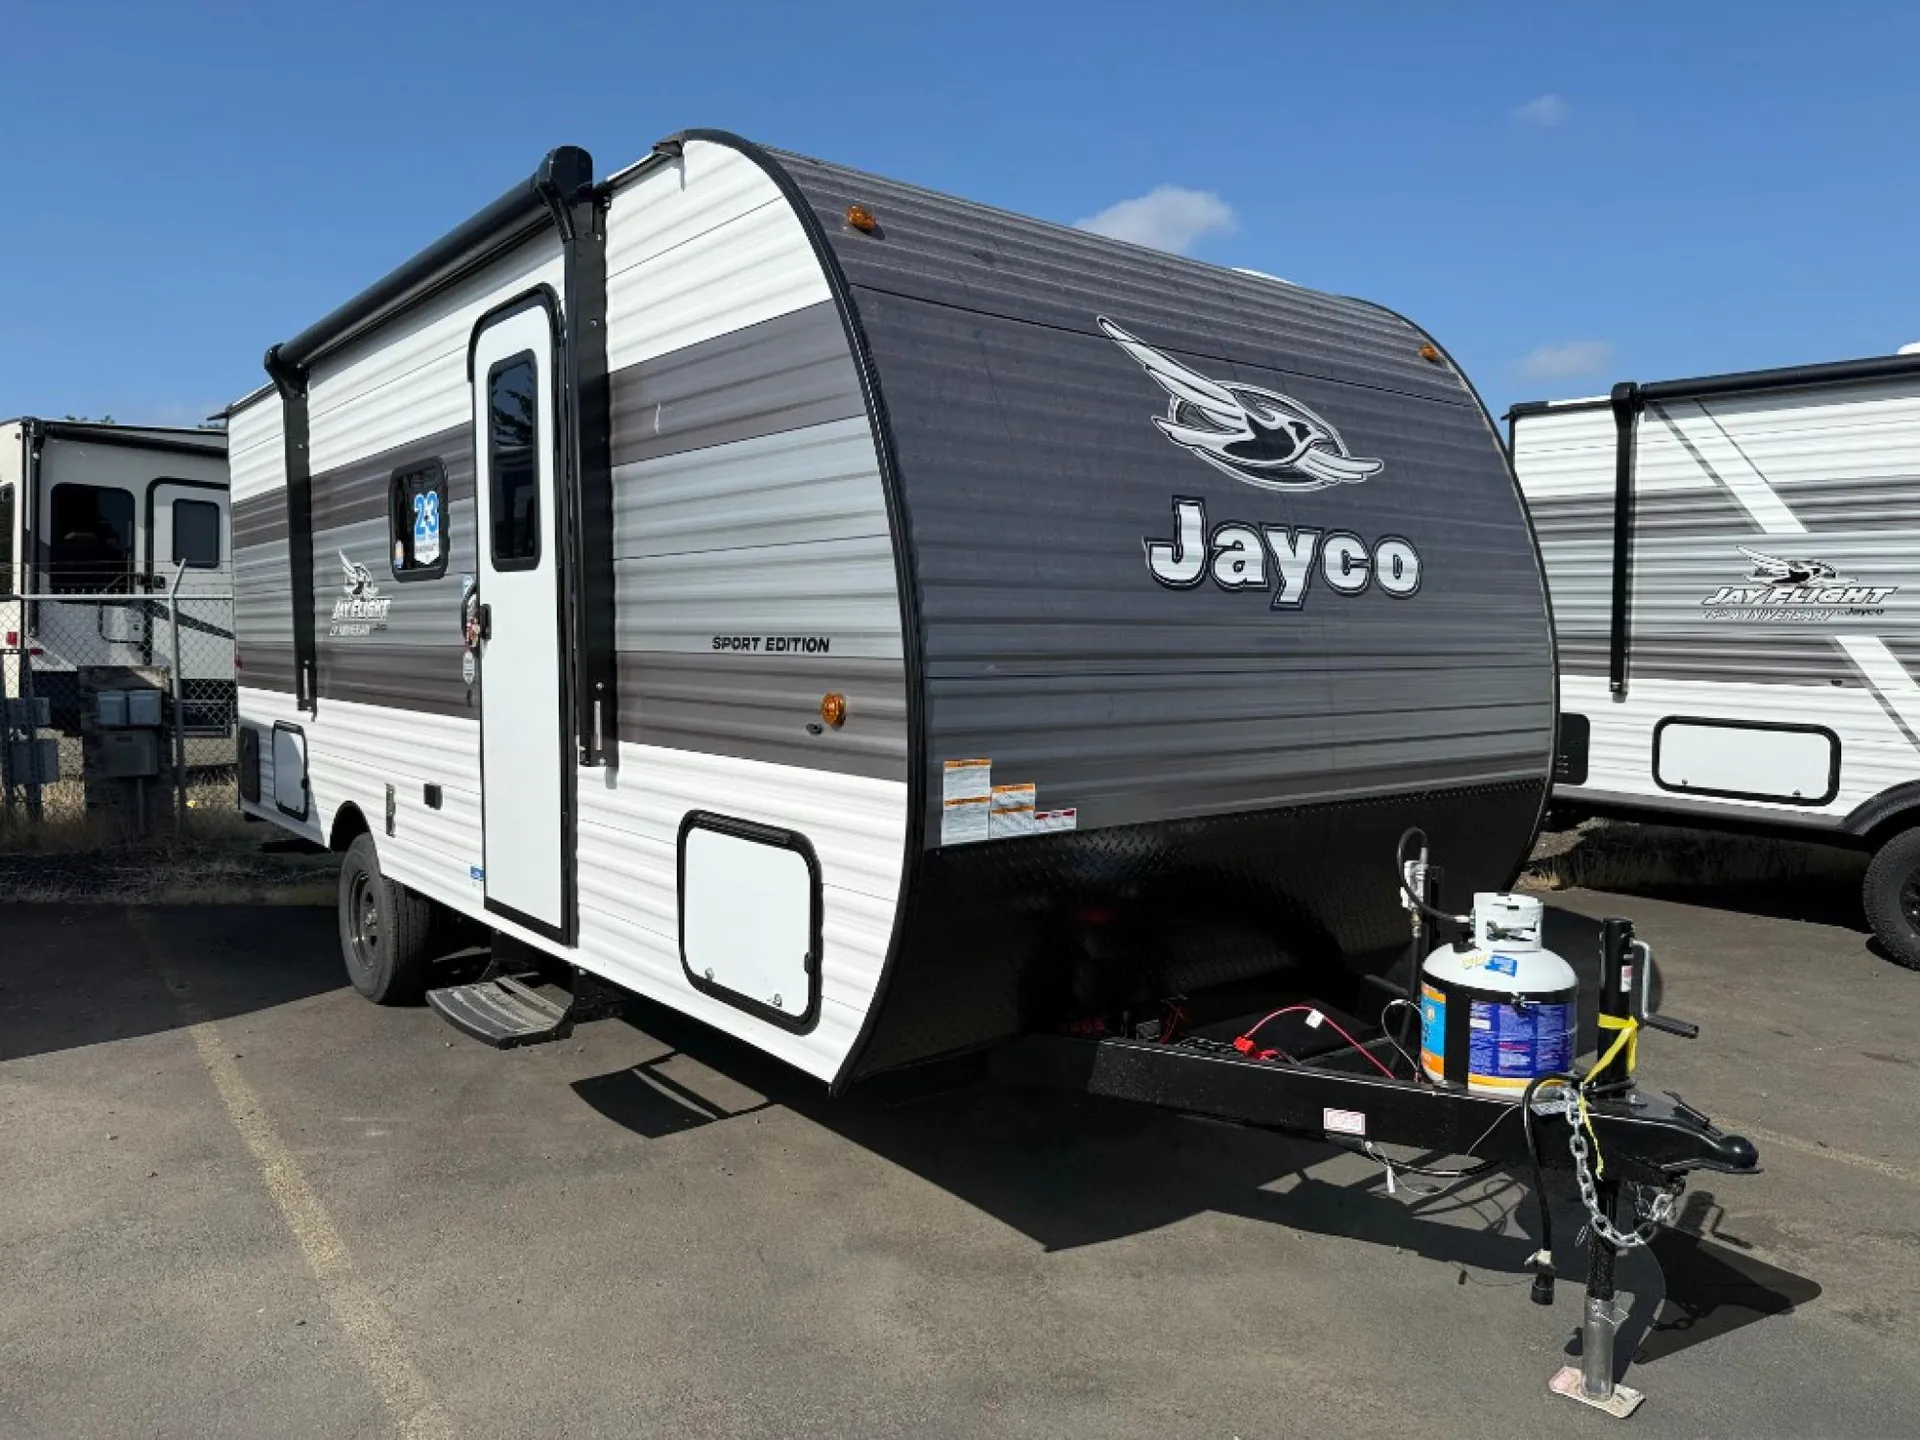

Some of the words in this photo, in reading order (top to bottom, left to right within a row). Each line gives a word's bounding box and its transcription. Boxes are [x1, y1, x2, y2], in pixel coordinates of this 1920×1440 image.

[414, 491, 440, 535] 23
[1143, 495, 1422, 611] Jayco
[1703, 587, 1767, 605] JAY
[1764, 586, 1898, 604] FLIGHT
[330, 596, 356, 621] JAY
[351, 597, 391, 621] FLIGHT
[712, 636, 762, 651] SPORT
[765, 636, 831, 654] EDITION
